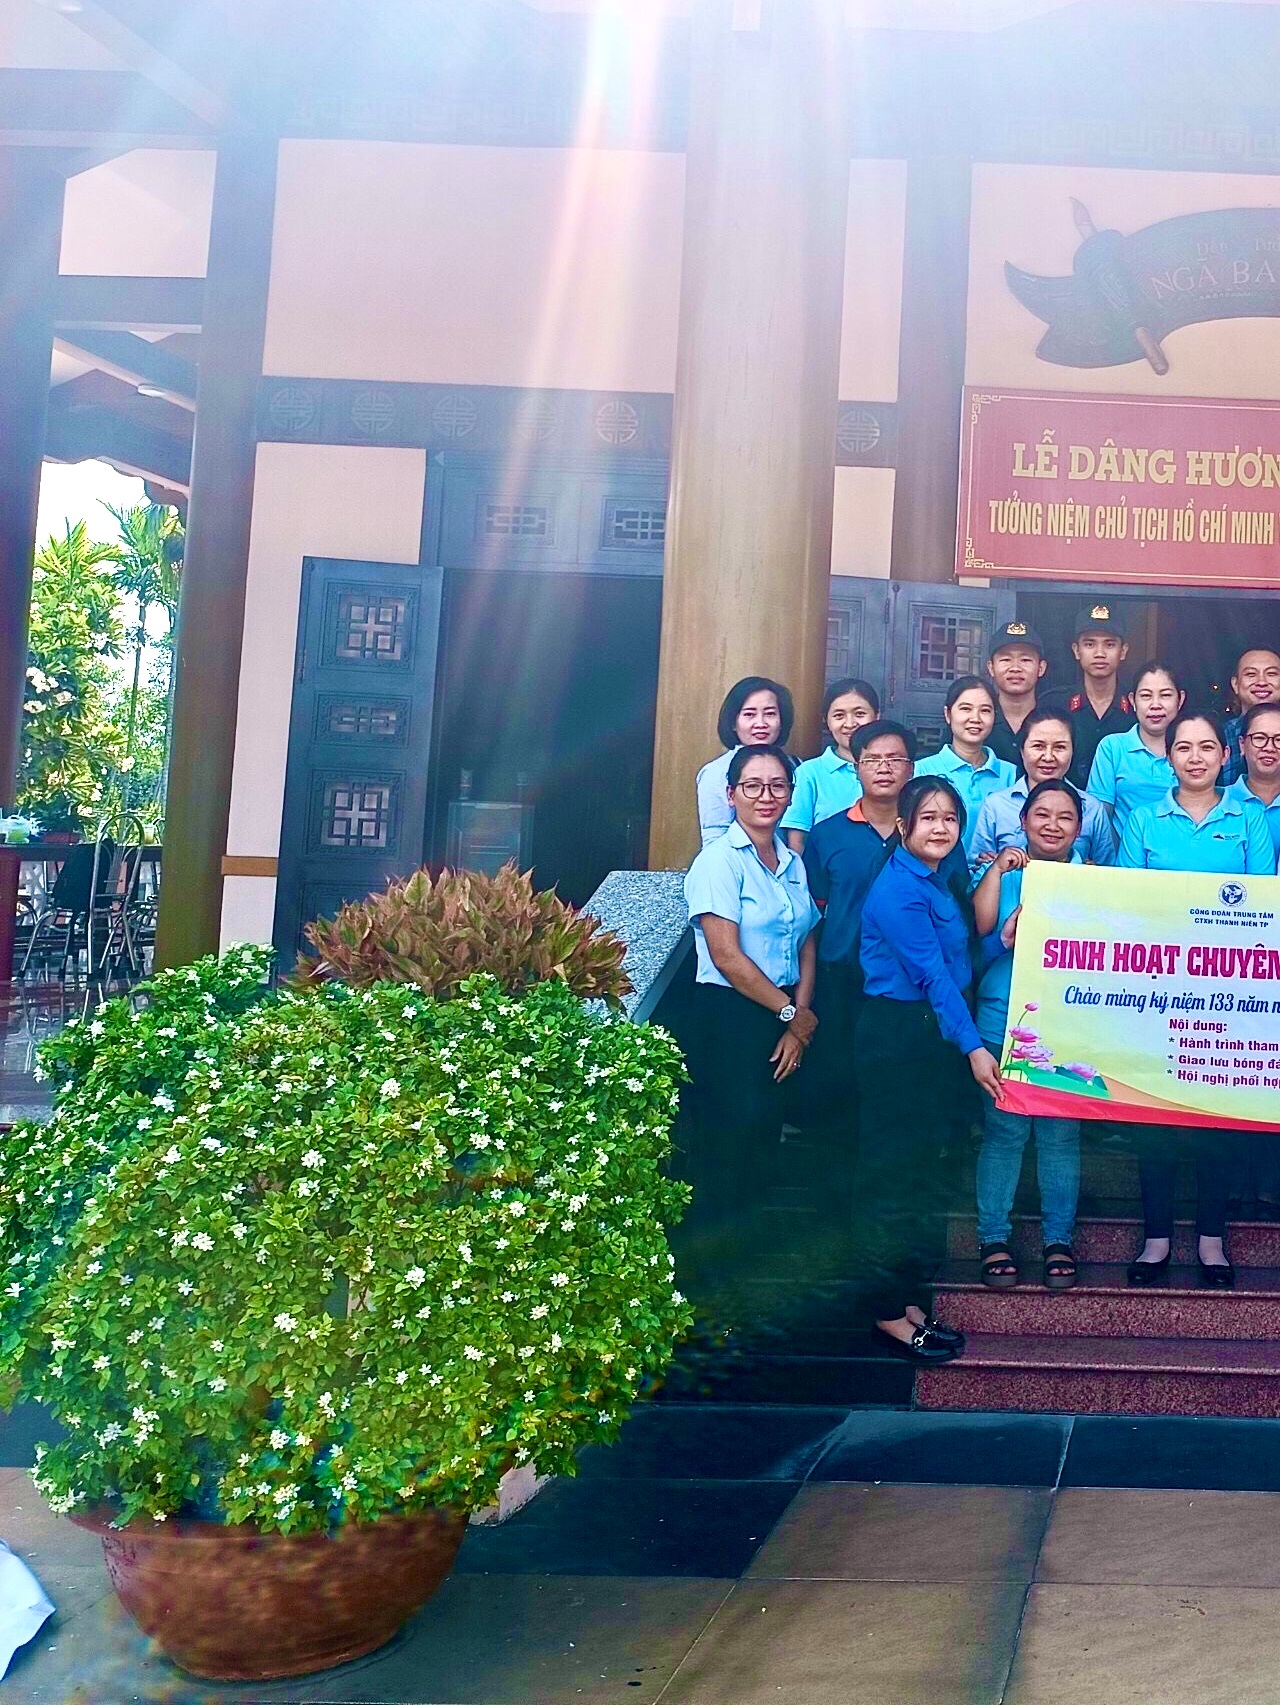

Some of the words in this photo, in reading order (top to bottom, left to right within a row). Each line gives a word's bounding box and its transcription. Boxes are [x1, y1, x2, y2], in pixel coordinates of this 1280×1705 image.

[1150, 257, 1219, 300] NGÃ
[1232, 259, 1276, 285] BA
[1012, 428, 1059, 479] LỄ
[1068, 438, 1177, 484] DÂNG
[989, 490, 1043, 536] TƯỞNG
[1046, 497, 1091, 545] NIỆM
[1094, 495, 1128, 540] CHỦ
[1132, 507, 1168, 548] TỊCH
[1172, 498, 1195, 542] HỒ
[1199, 503, 1228, 543] CHÍ
[1231, 510, 1275, 545] MINH
[1194, 917, 1214, 925] CTXH
[1233, 911, 1257, 919] TRUNG
[1043, 938, 1106, 972] SINH
[1111, 942, 1181, 980] HOẠT
[1064, 985, 1101, 1005] Chào
[1104, 988, 1147, 1014] mừng
[1171, 991, 1206, 1014] niệm
[1208, 992, 1235, 1013] 133
[1236, 995, 1269, 1014] năm
[1169, 1018, 1189, 1032] Nội
[1192, 1019, 1228, 1034] dung:
[1179, 1037, 1211, 1050] Hành
[1215, 1038, 1244, 1051] trình
[1248, 1040, 1279, 1052] tham
[1178, 1054, 1206, 1066] Giao
[1209, 1056, 1229, 1068] lưu
[1233, 1057, 1263, 1070] bóng
[1177, 1069, 1198, 1083] Hội
[1202, 1072, 1229, 1086] nghị
[1232, 1074, 1259, 1087] phối
